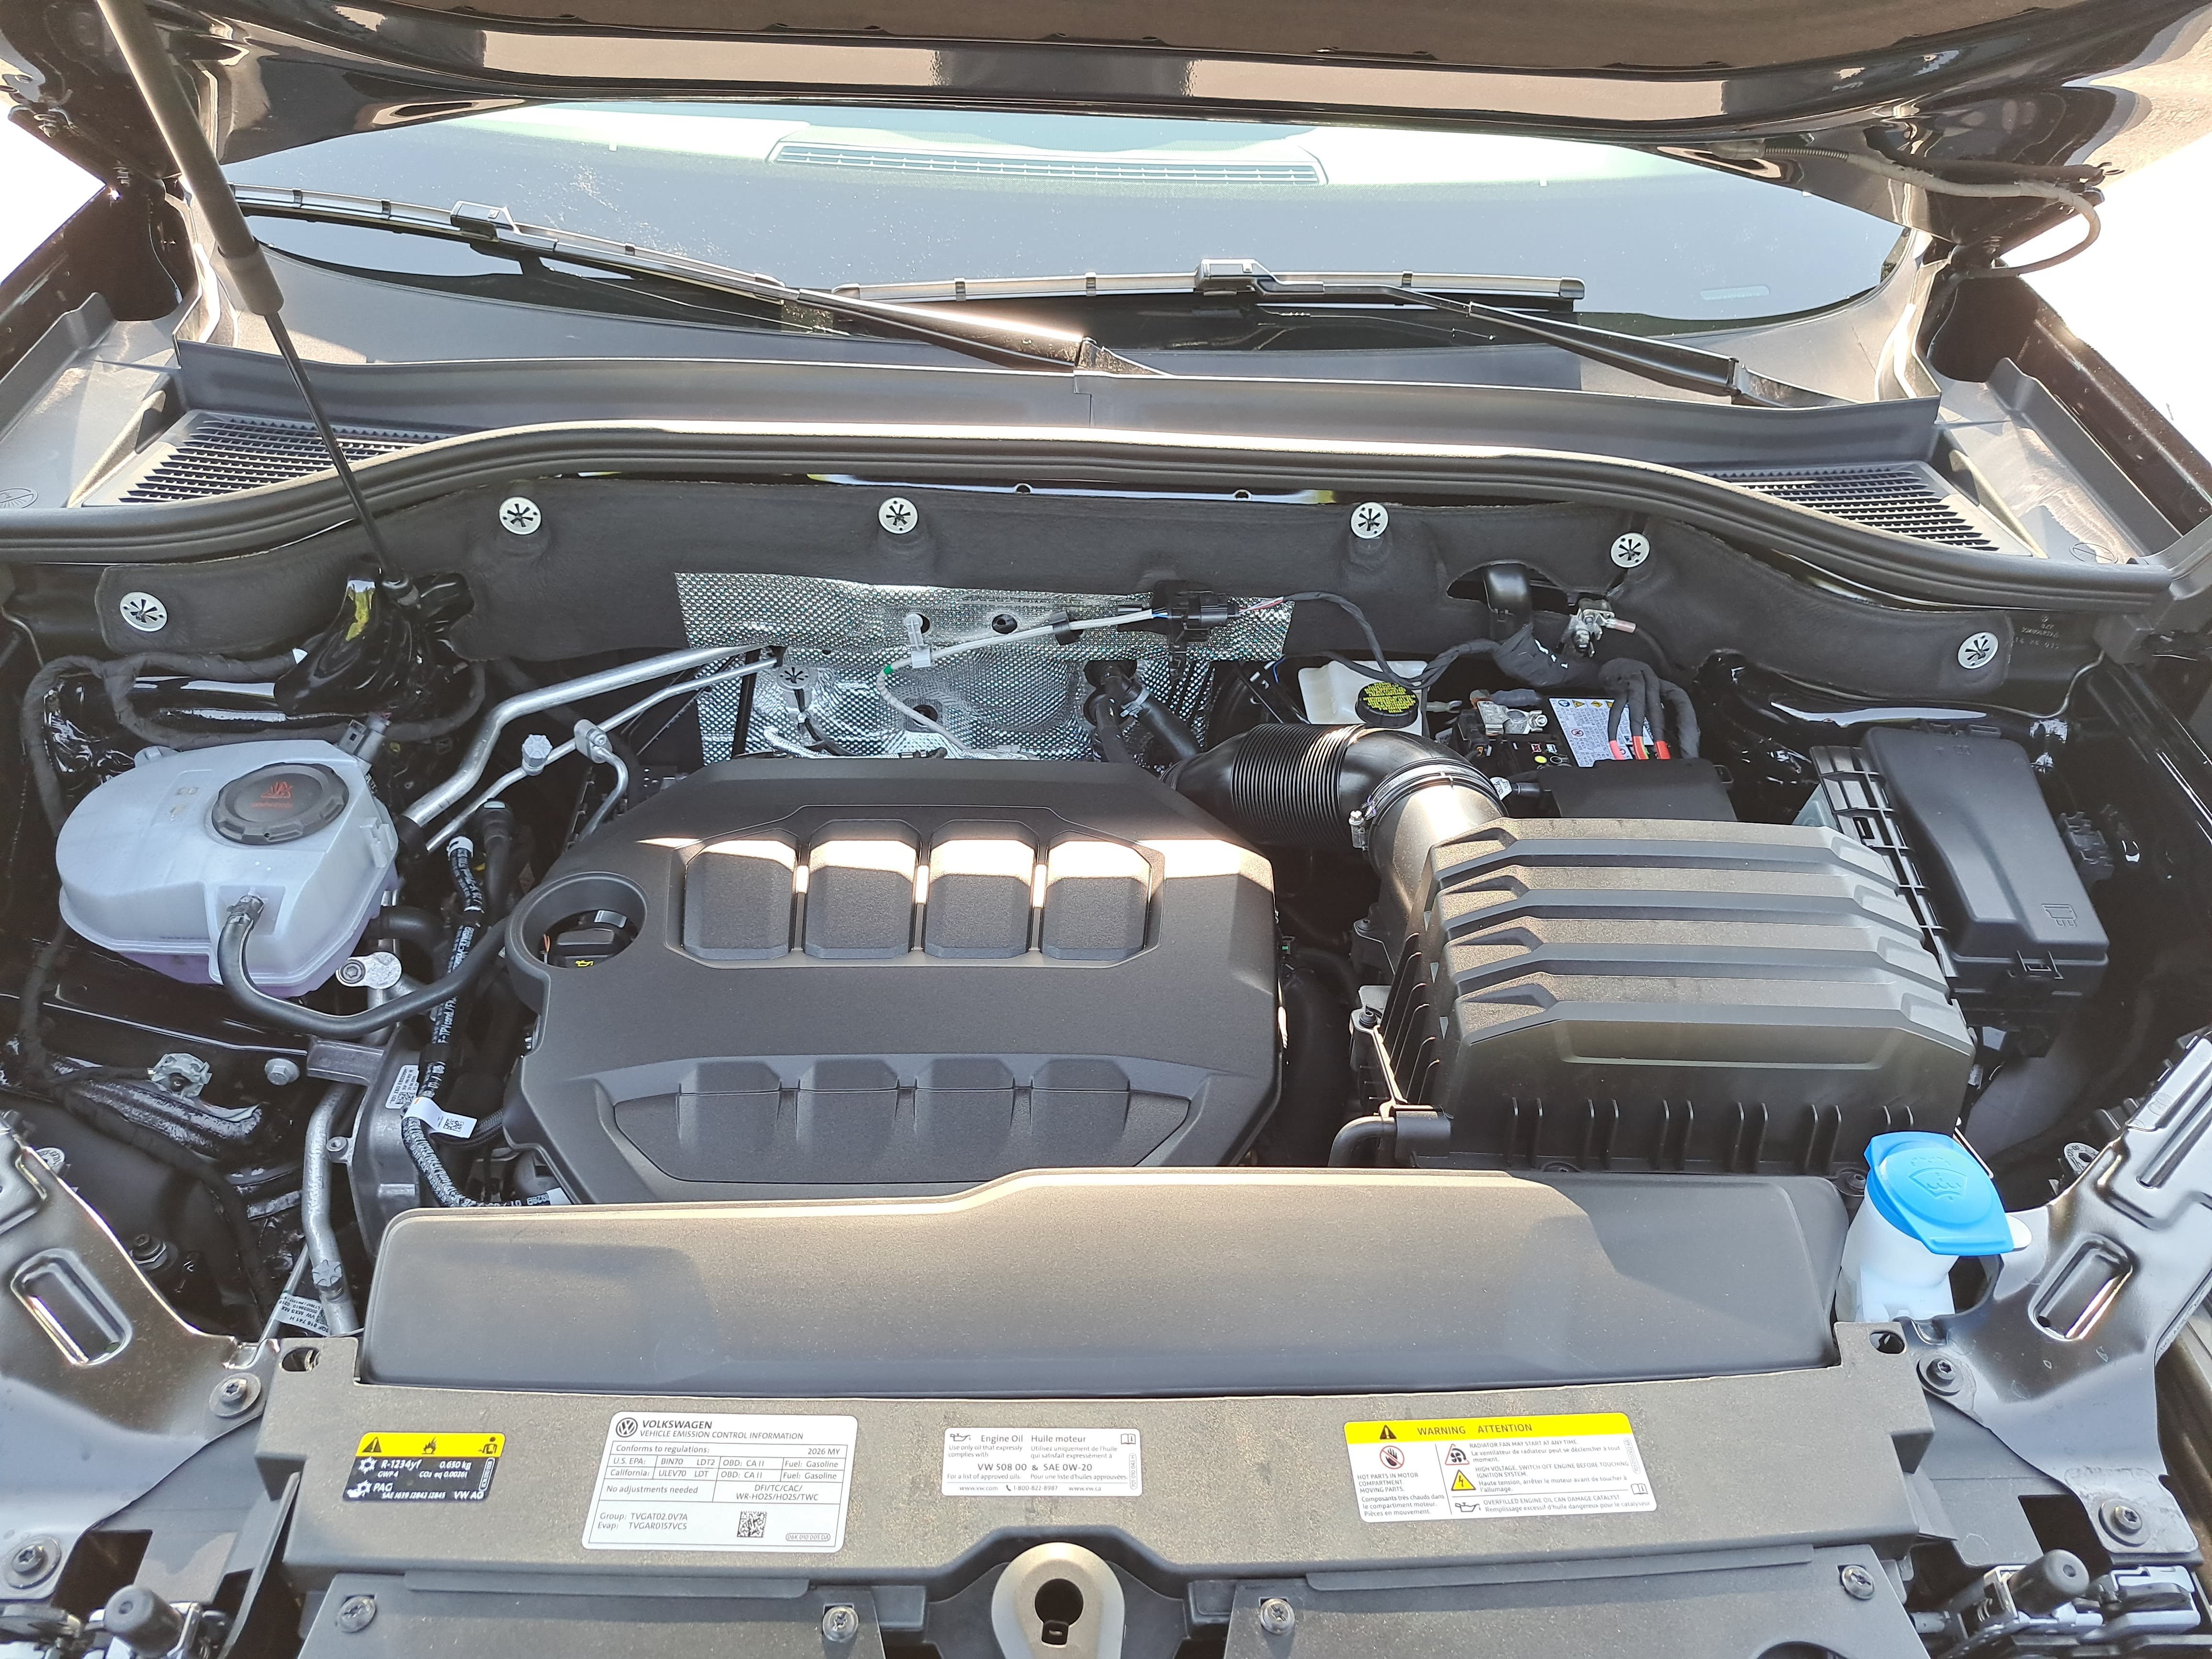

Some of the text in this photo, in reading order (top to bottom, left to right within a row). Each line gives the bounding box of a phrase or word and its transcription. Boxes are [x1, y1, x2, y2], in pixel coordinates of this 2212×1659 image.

[642, 1420, 712, 1429] VOLKSWAGEN
[1417, 1424, 1532, 1436] WARNING ATTENTION
[981, 1435, 1009, 1444] Engine
[664, 1446, 709, 1454] regulations:
[619, 1485, 667, 1494] adjustments
[454, 1491, 470, 1500] VW
[600, 1513, 627, 1521] Group:
[598, 1522, 618, 1530] Evap:
